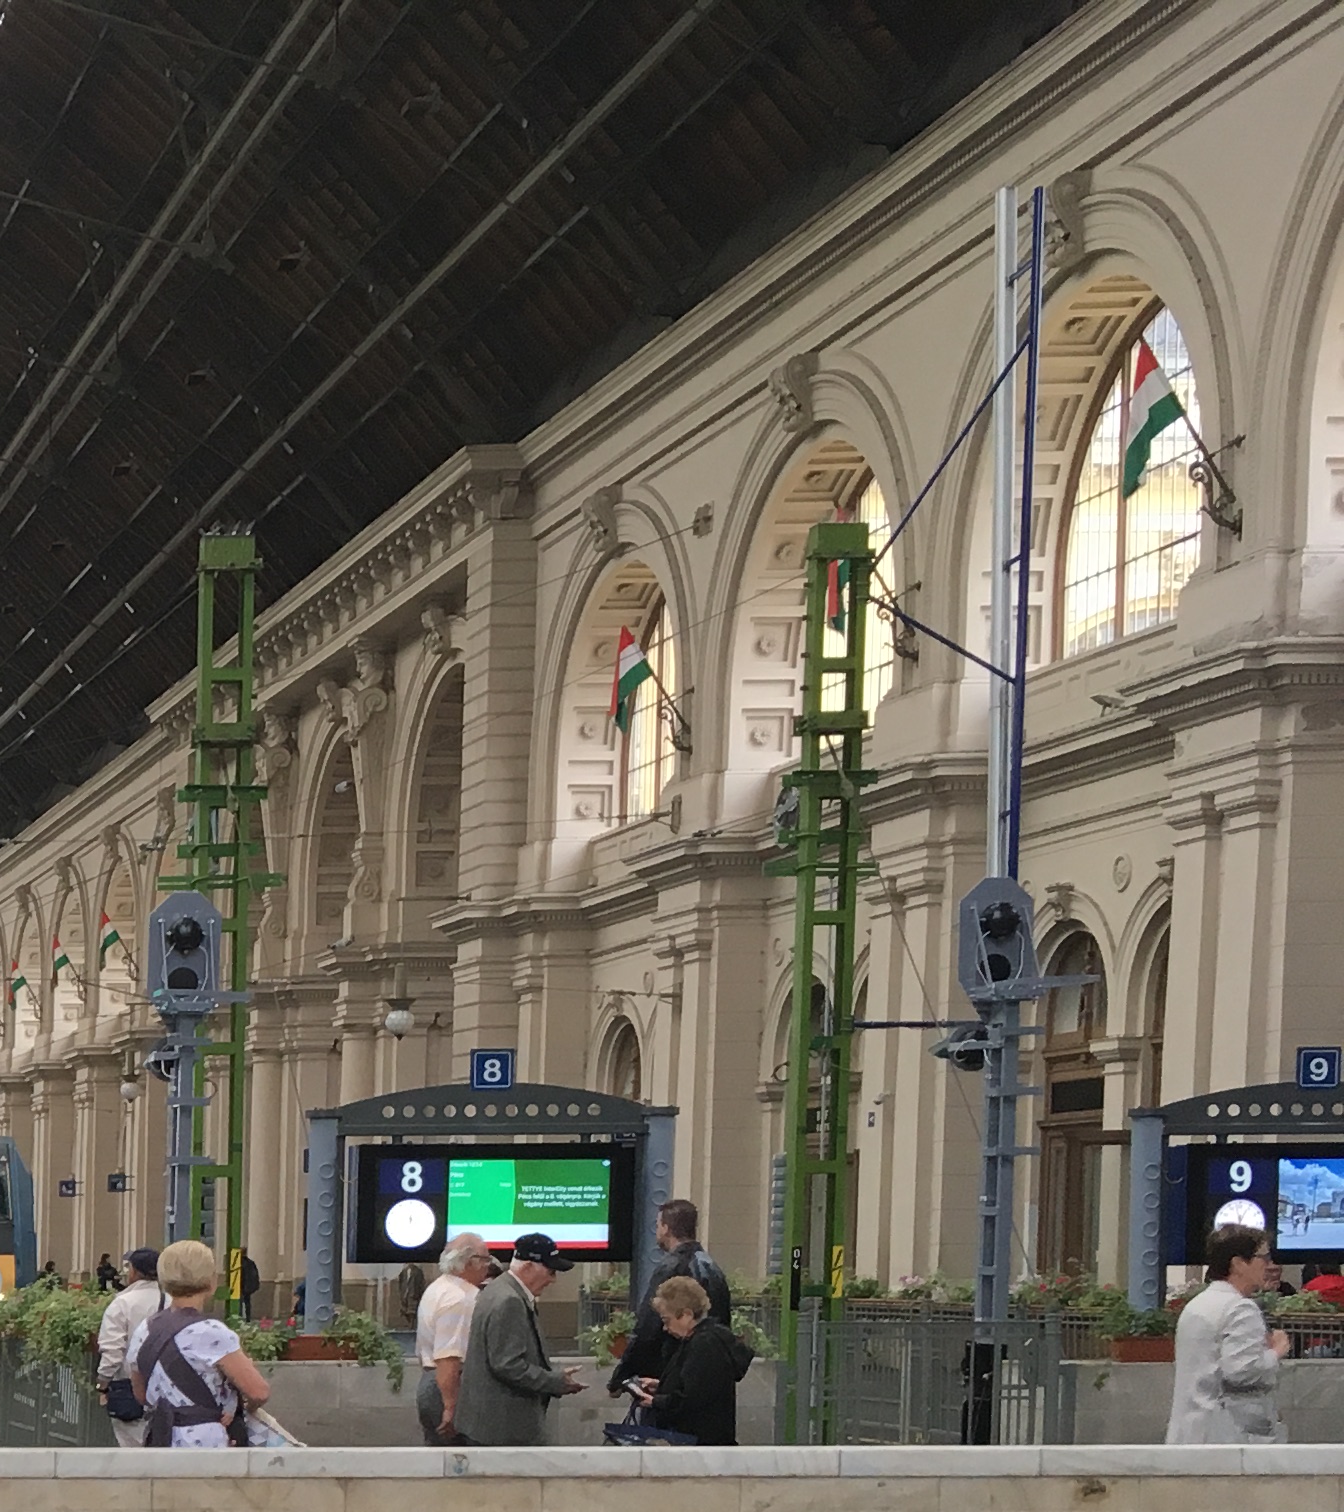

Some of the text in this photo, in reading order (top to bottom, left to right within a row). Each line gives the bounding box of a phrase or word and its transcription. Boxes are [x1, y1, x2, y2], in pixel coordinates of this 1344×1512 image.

[484, 1059, 501, 1082] 8
[1310, 1058, 1328, 1081] 9
[402, 1162, 422, 1192] 8
[1230, 1161, 1252, 1192] 9
